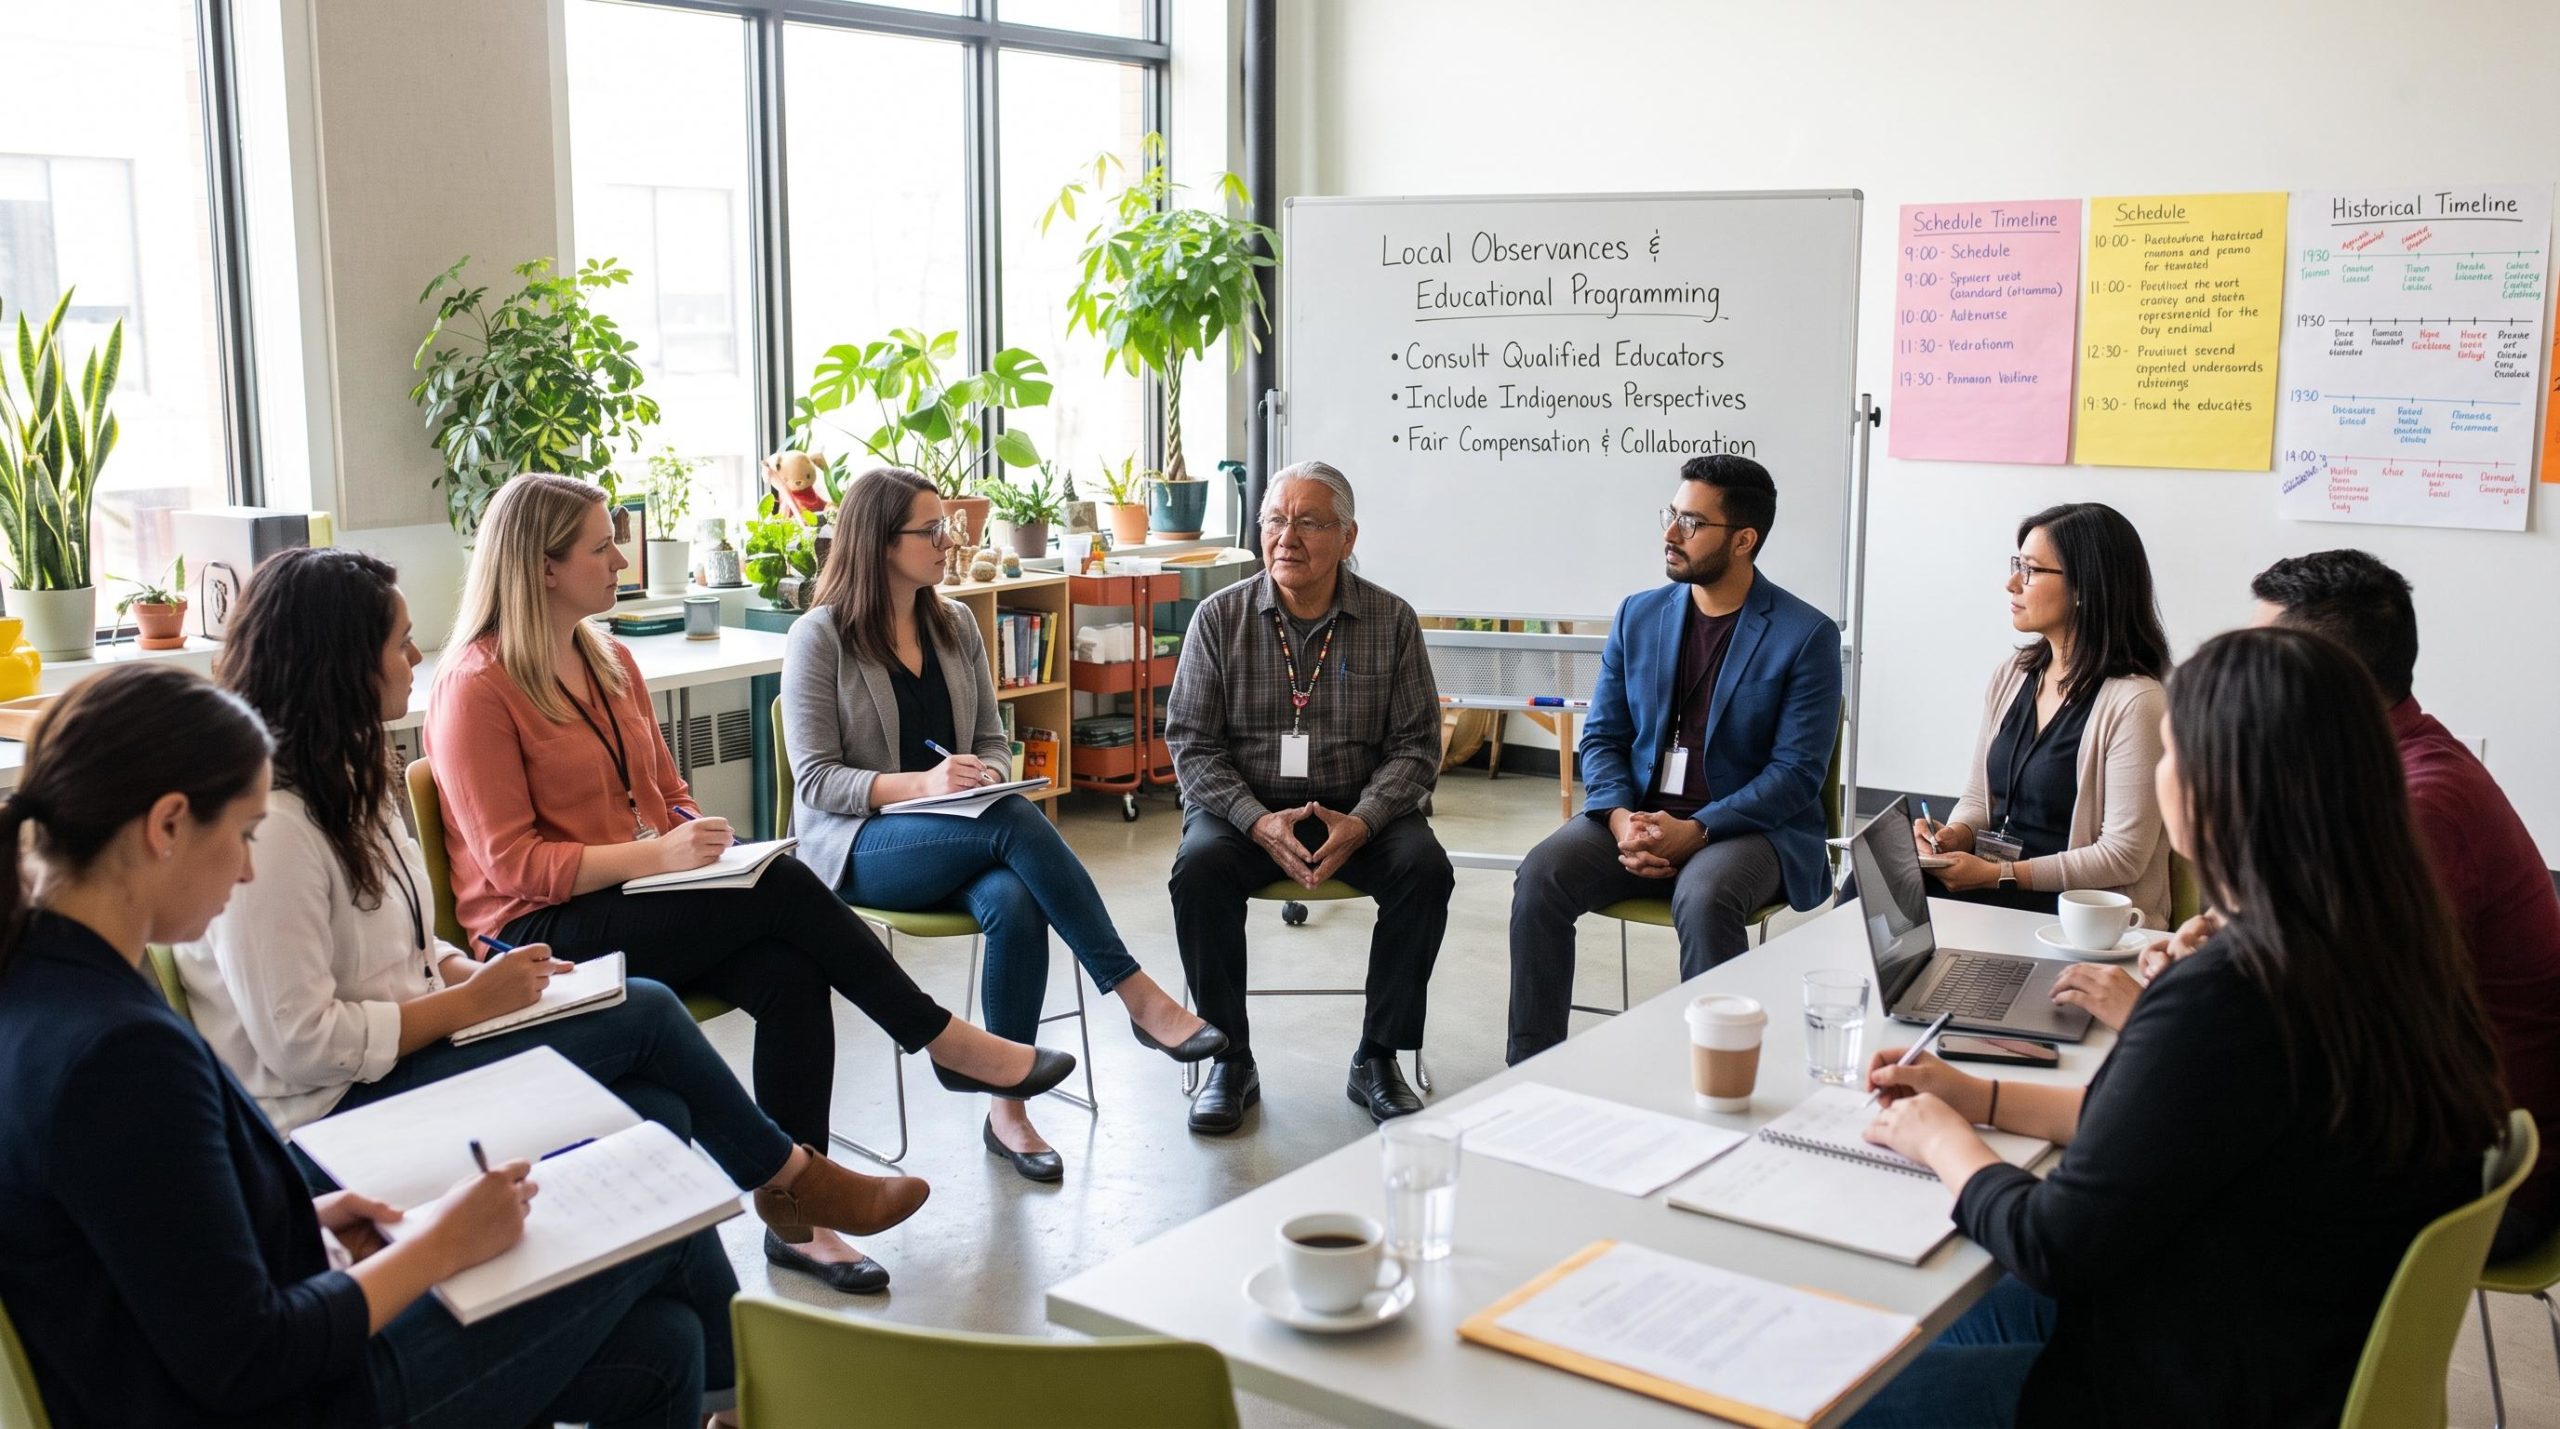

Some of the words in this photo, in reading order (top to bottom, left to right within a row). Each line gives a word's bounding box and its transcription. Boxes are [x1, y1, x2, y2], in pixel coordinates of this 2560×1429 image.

[2115, 203, 2186, 221] Schedule
[2333, 194, 2422, 220] Historical
[2435, 192, 2518, 215] Timeline
[1913, 211, 1982, 232] Schedule
[1992, 209, 2058, 228] Timeline
[1382, 232, 1451, 267] Local
[1472, 231, 1630, 264] Observances
[1951, 244, 2010, 259] Schedule
[2189, 247, 2210, 257] and
[2145, 261, 2160, 272] for
[1417, 277, 1553, 311] Educational
[1571, 273, 1721, 323] Programming
[2185, 294, 2205, 304] and
[2239, 306, 2259, 317] the
[1406, 341, 1490, 370] Consult
[1503, 340, 1600, 369] Qualified
[1616, 340, 1725, 368] Educators
[1406, 384, 1488, 410] Include
[1499, 383, 1613, 419] Indigenous
[1624, 381, 1747, 415] Perspectives
[2173, 399, 2191, 411] the
[1408, 425, 1448, 453] Fair
[1459, 426, 1590, 461] Compensation
[1620, 427, 1756, 457] Collaboration
